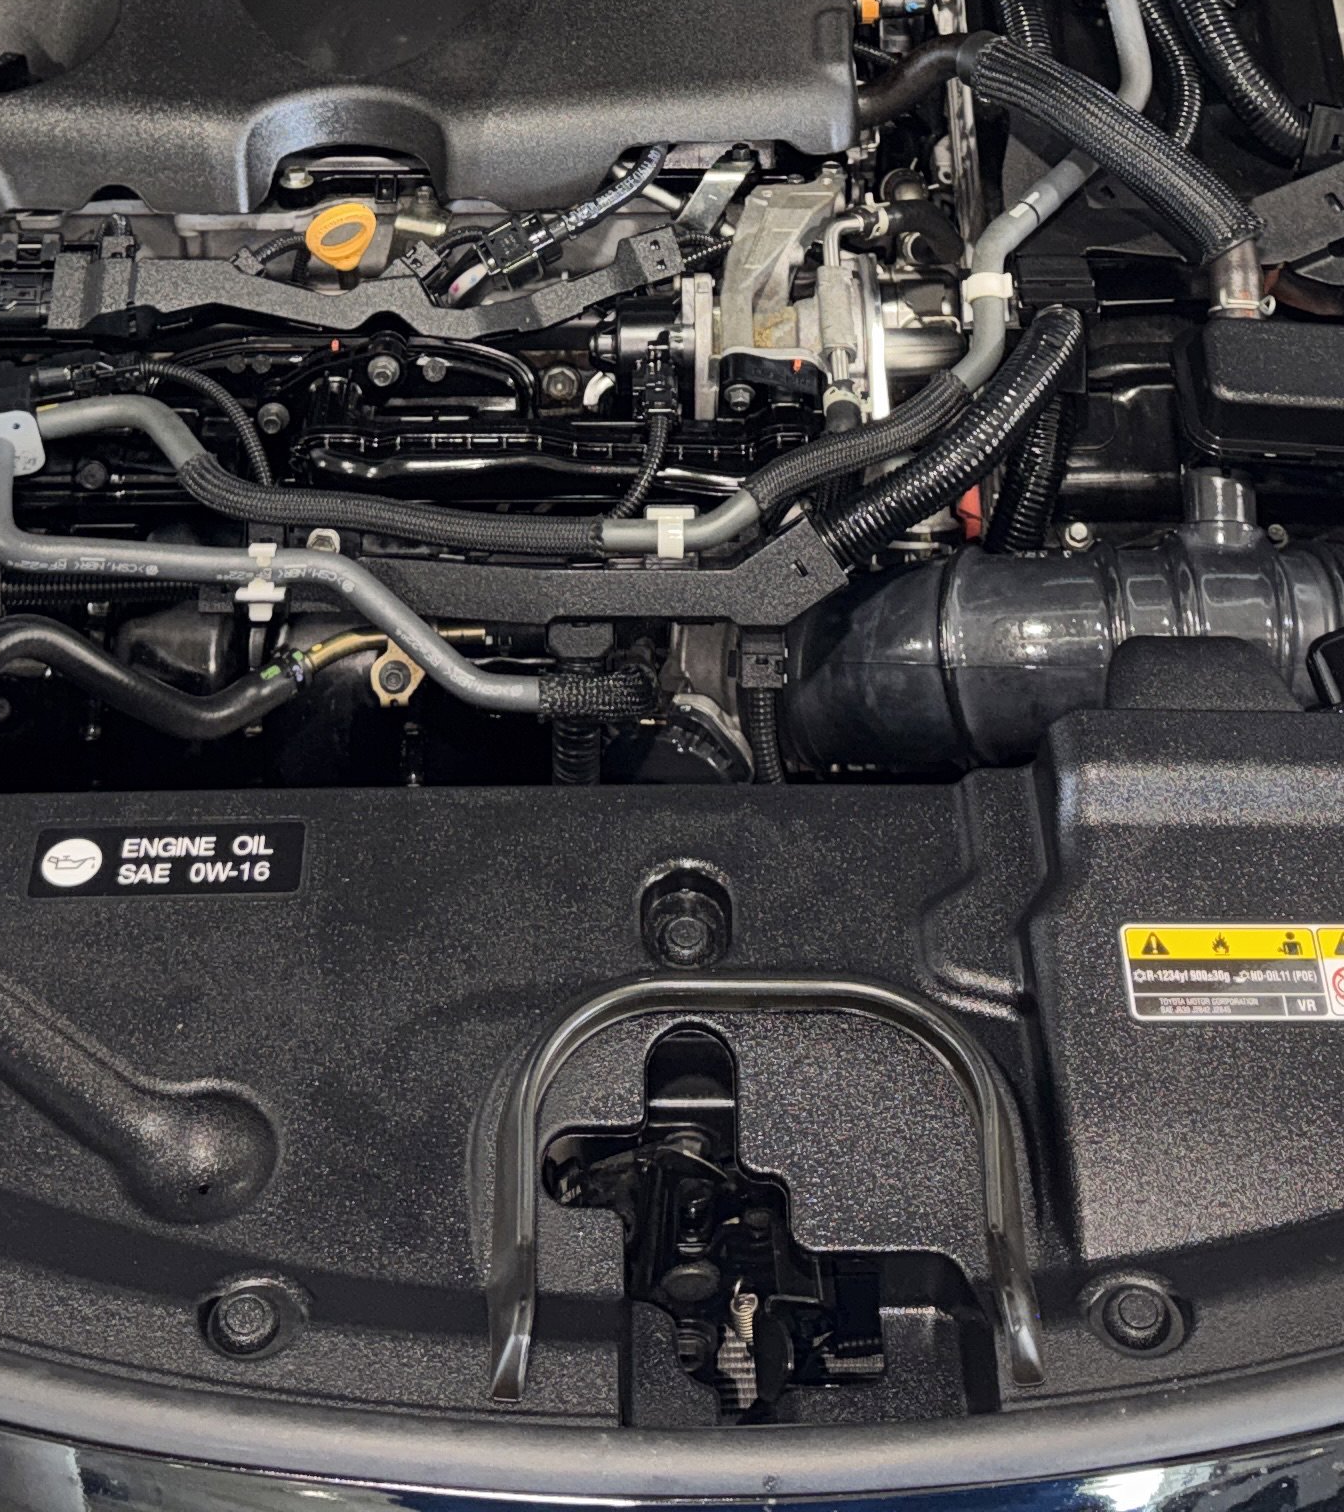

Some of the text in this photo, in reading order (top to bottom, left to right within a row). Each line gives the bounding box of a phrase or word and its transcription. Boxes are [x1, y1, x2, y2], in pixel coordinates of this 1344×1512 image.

[121, 835, 274, 858] ENGINE OIL
[117, 861, 271, 885] SAE 0W-16
[1293, 970, 1318, 983] (POE)
[1159, 997, 1186, 1006] TOYOTA
[1296, 998, 1318, 1013] VR
